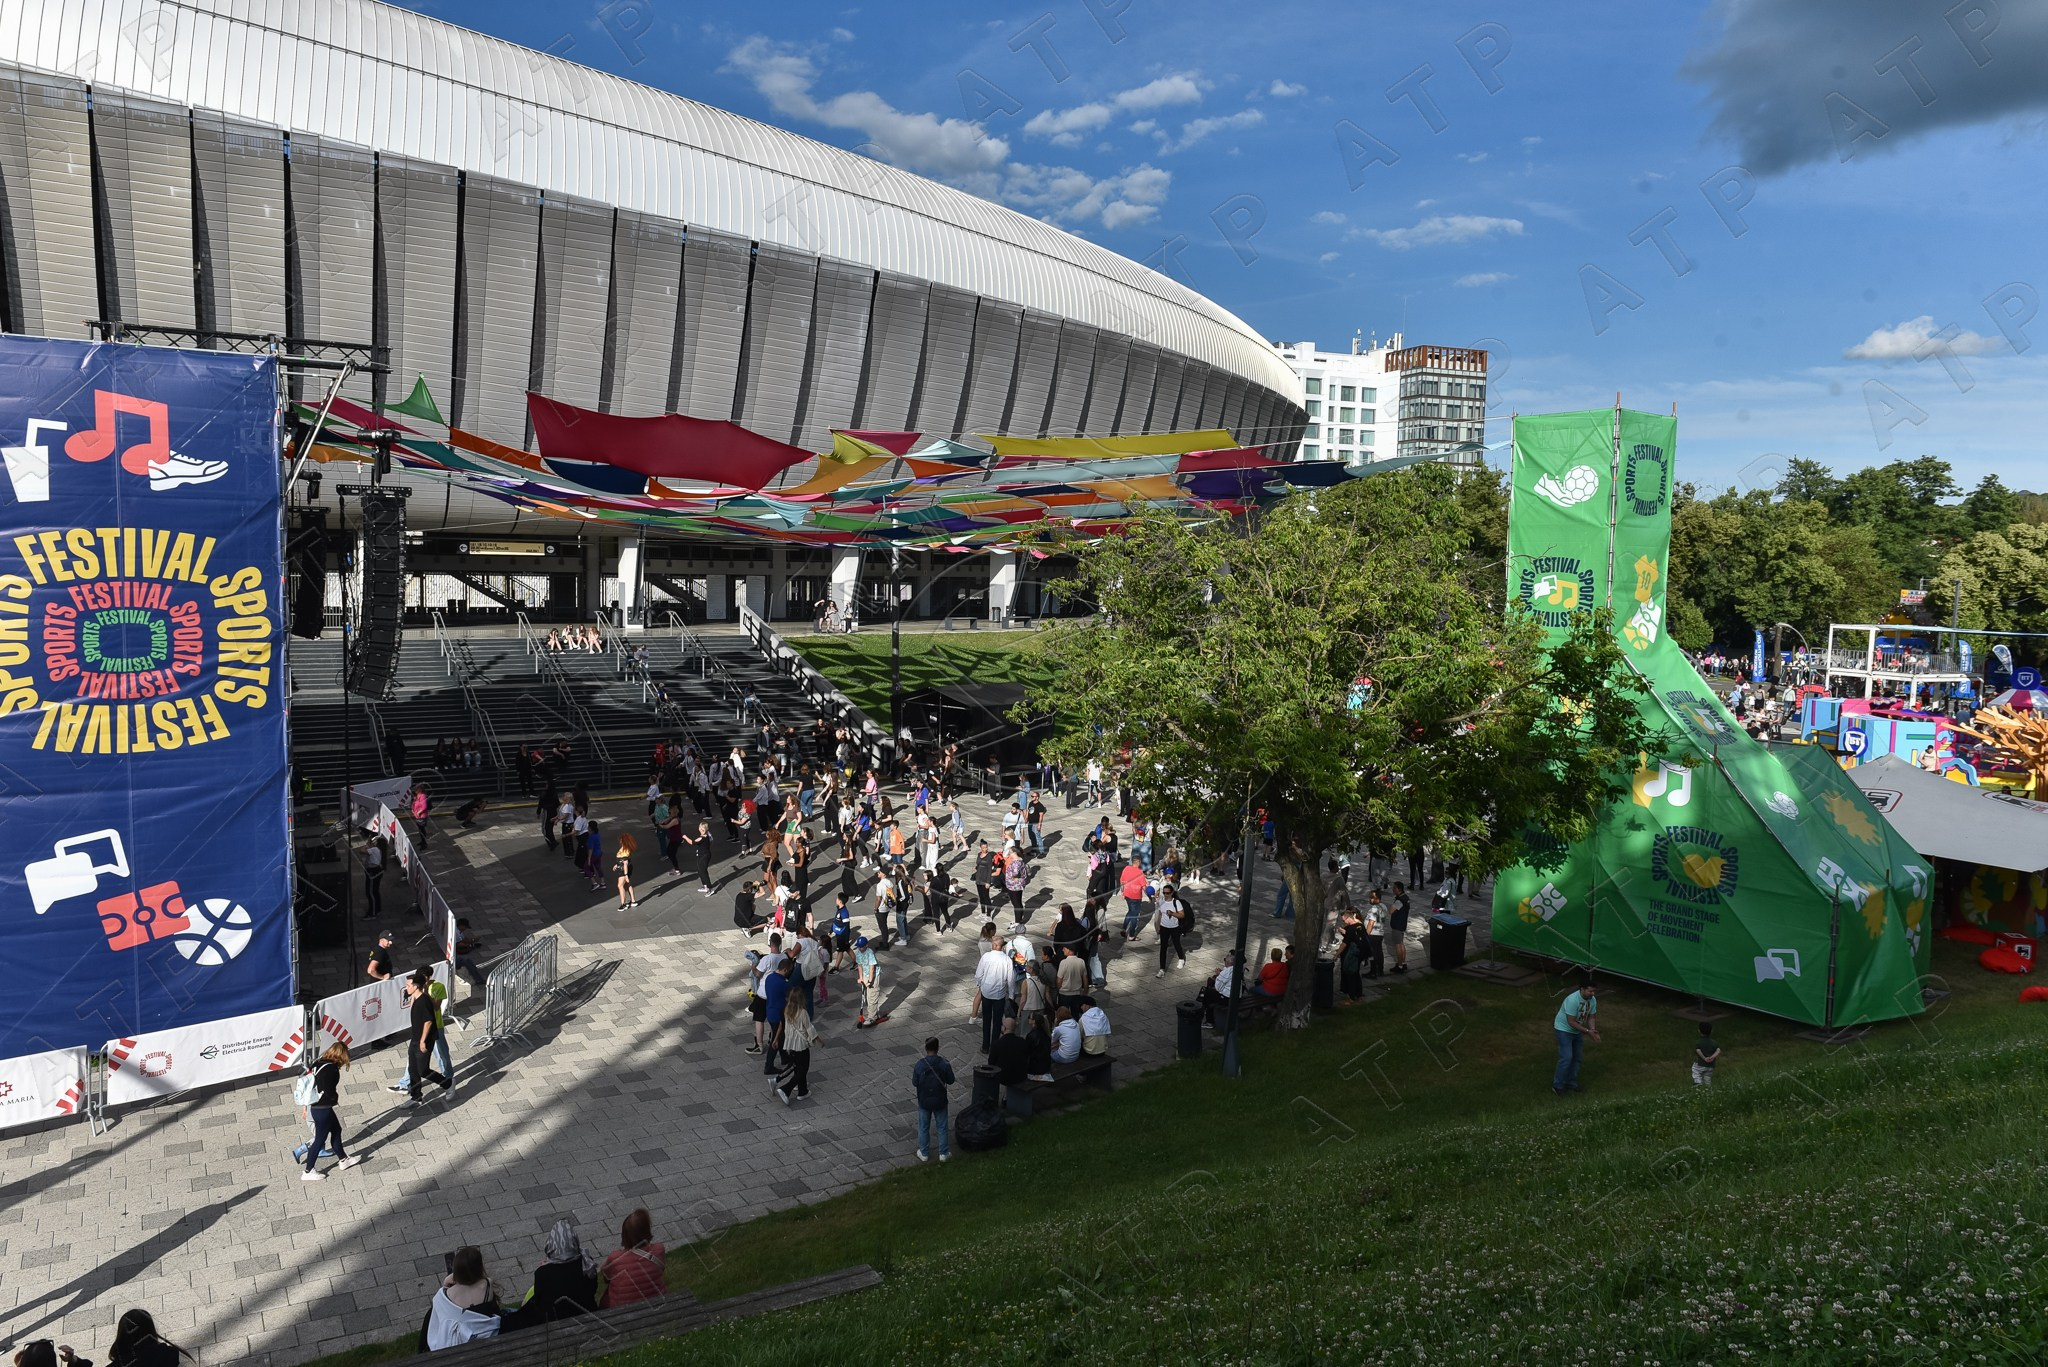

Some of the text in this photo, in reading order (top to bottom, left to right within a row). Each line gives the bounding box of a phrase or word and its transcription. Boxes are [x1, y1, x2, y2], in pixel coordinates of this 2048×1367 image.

[1634, 444, 1663, 463] FESTIVAL
[1625, 454, 1636, 502] SPORTS
[1658, 459, 1668, 506] SPORTS
[14, 528, 216, 585] FESTIVAL
[1533, 557, 1580, 574] FESTIVAL
[68, 581, 172, 612] FESTIVAL
[95, 610, 151, 626] FESTIVAL
[43, 602, 80, 681] SPORTS
[83, 620, 102, 663] SPORTS
[150, 619, 168, 660] SPORTS
[169, 601, 203, 677] SPORTS
[209, 566, 272, 709] SPORTS
[100, 656, 156, 672] FESTIVAL
[77, 668, 181, 699] FESTIVAL
[32, 694, 231, 754] FESTIVAL
[1849, 737, 1860, 745] BT
[1666, 826, 1724, 849] FESTIVAL
[1652, 834, 1670, 881] SPORTS
[1718, 847, 1738, 897] SPORTS
[1648, 911, 1705, 932] OF MOVEMENT
[1649, 900, 1720, 924] THE GRAND STAGE
[1647, 923, 1701, 943] CELEBRATION
[253, 1035, 273, 1044] Energie
[7, 1095, 34, 1105] MARIA
